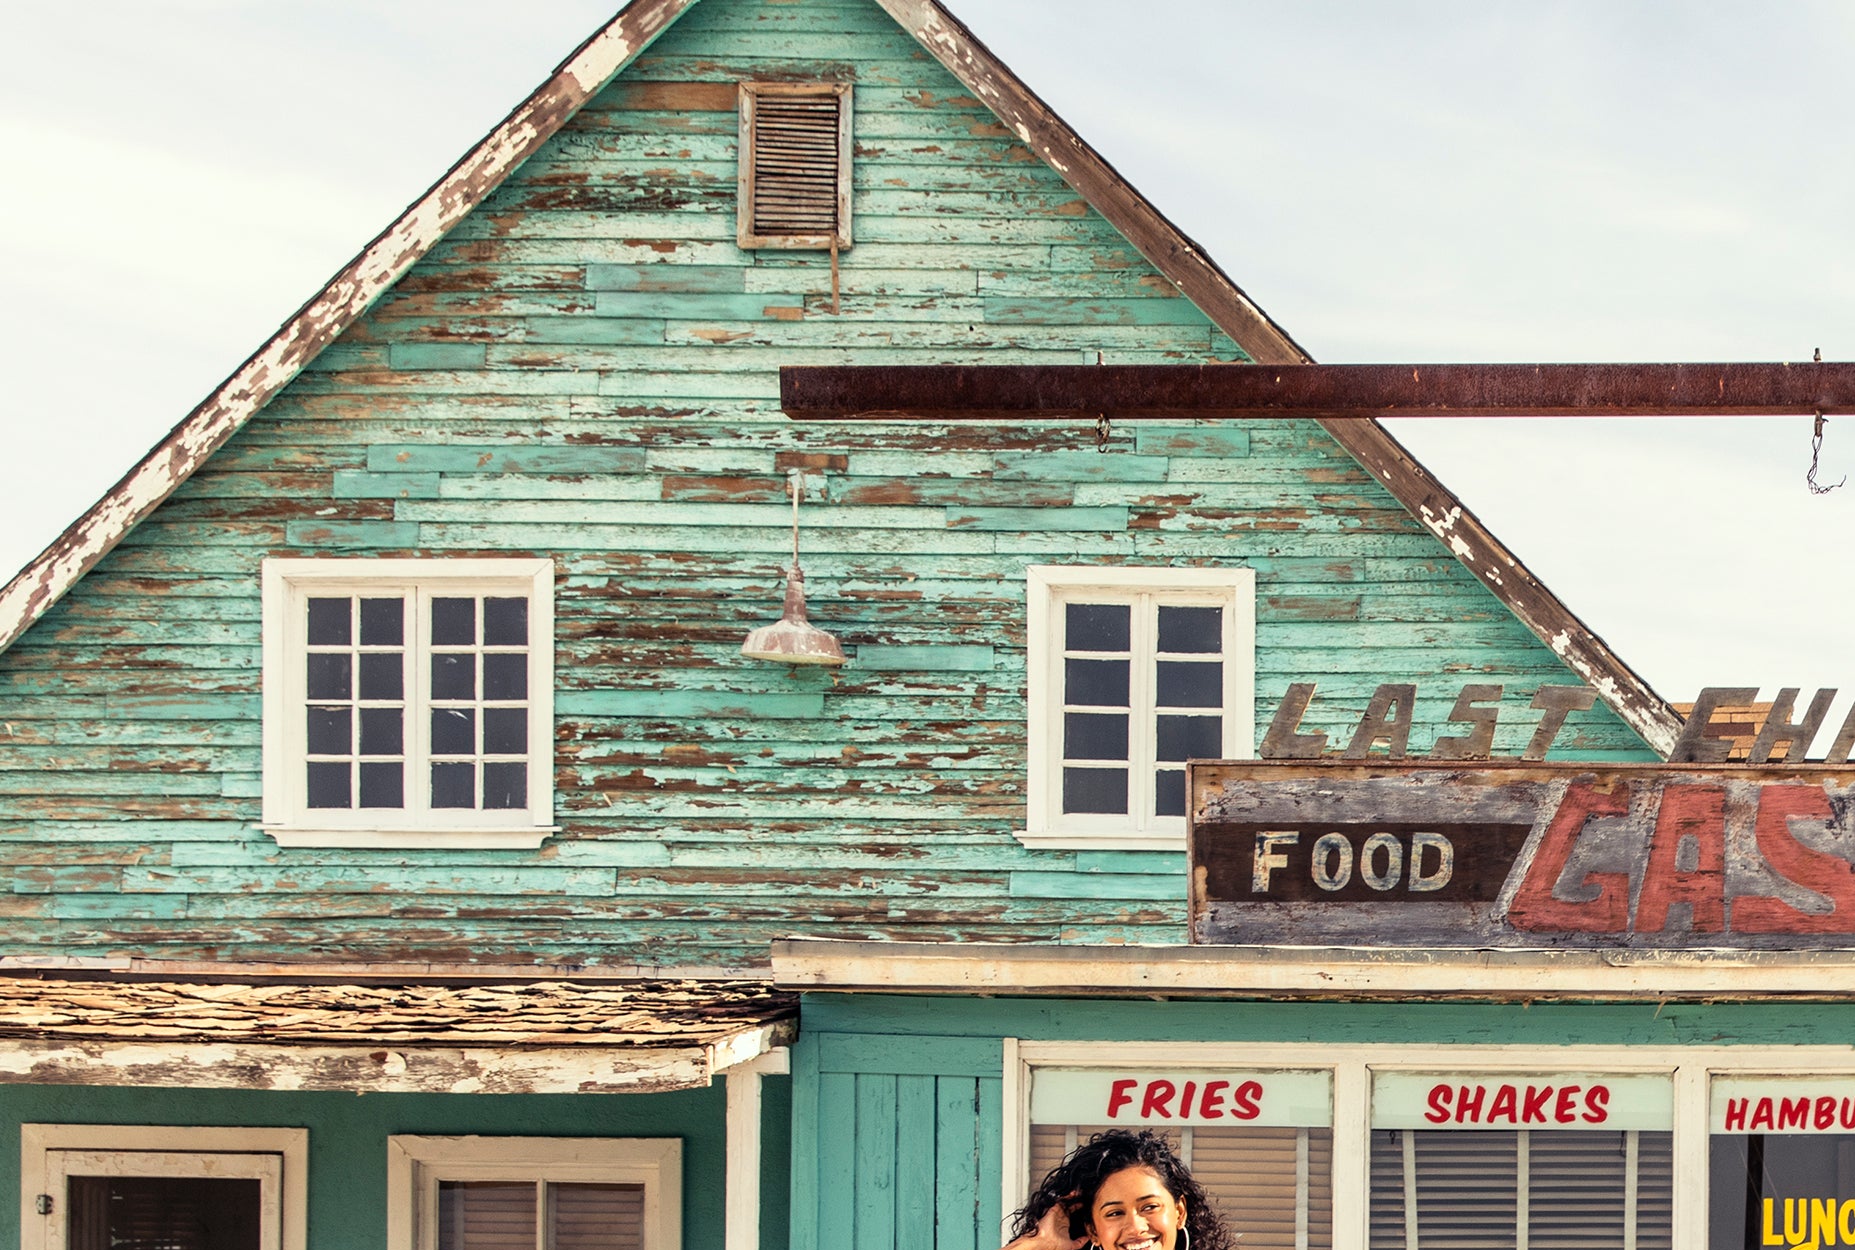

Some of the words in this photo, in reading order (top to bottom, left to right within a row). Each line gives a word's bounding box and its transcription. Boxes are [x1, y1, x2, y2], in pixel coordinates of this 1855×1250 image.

[1259, 683, 1600, 761] LAST
[1252, 831, 1455, 893] FOOD
[1107, 1079, 1263, 1120] FRIES
[1424, 1084, 1610, 1124] SHAKES
